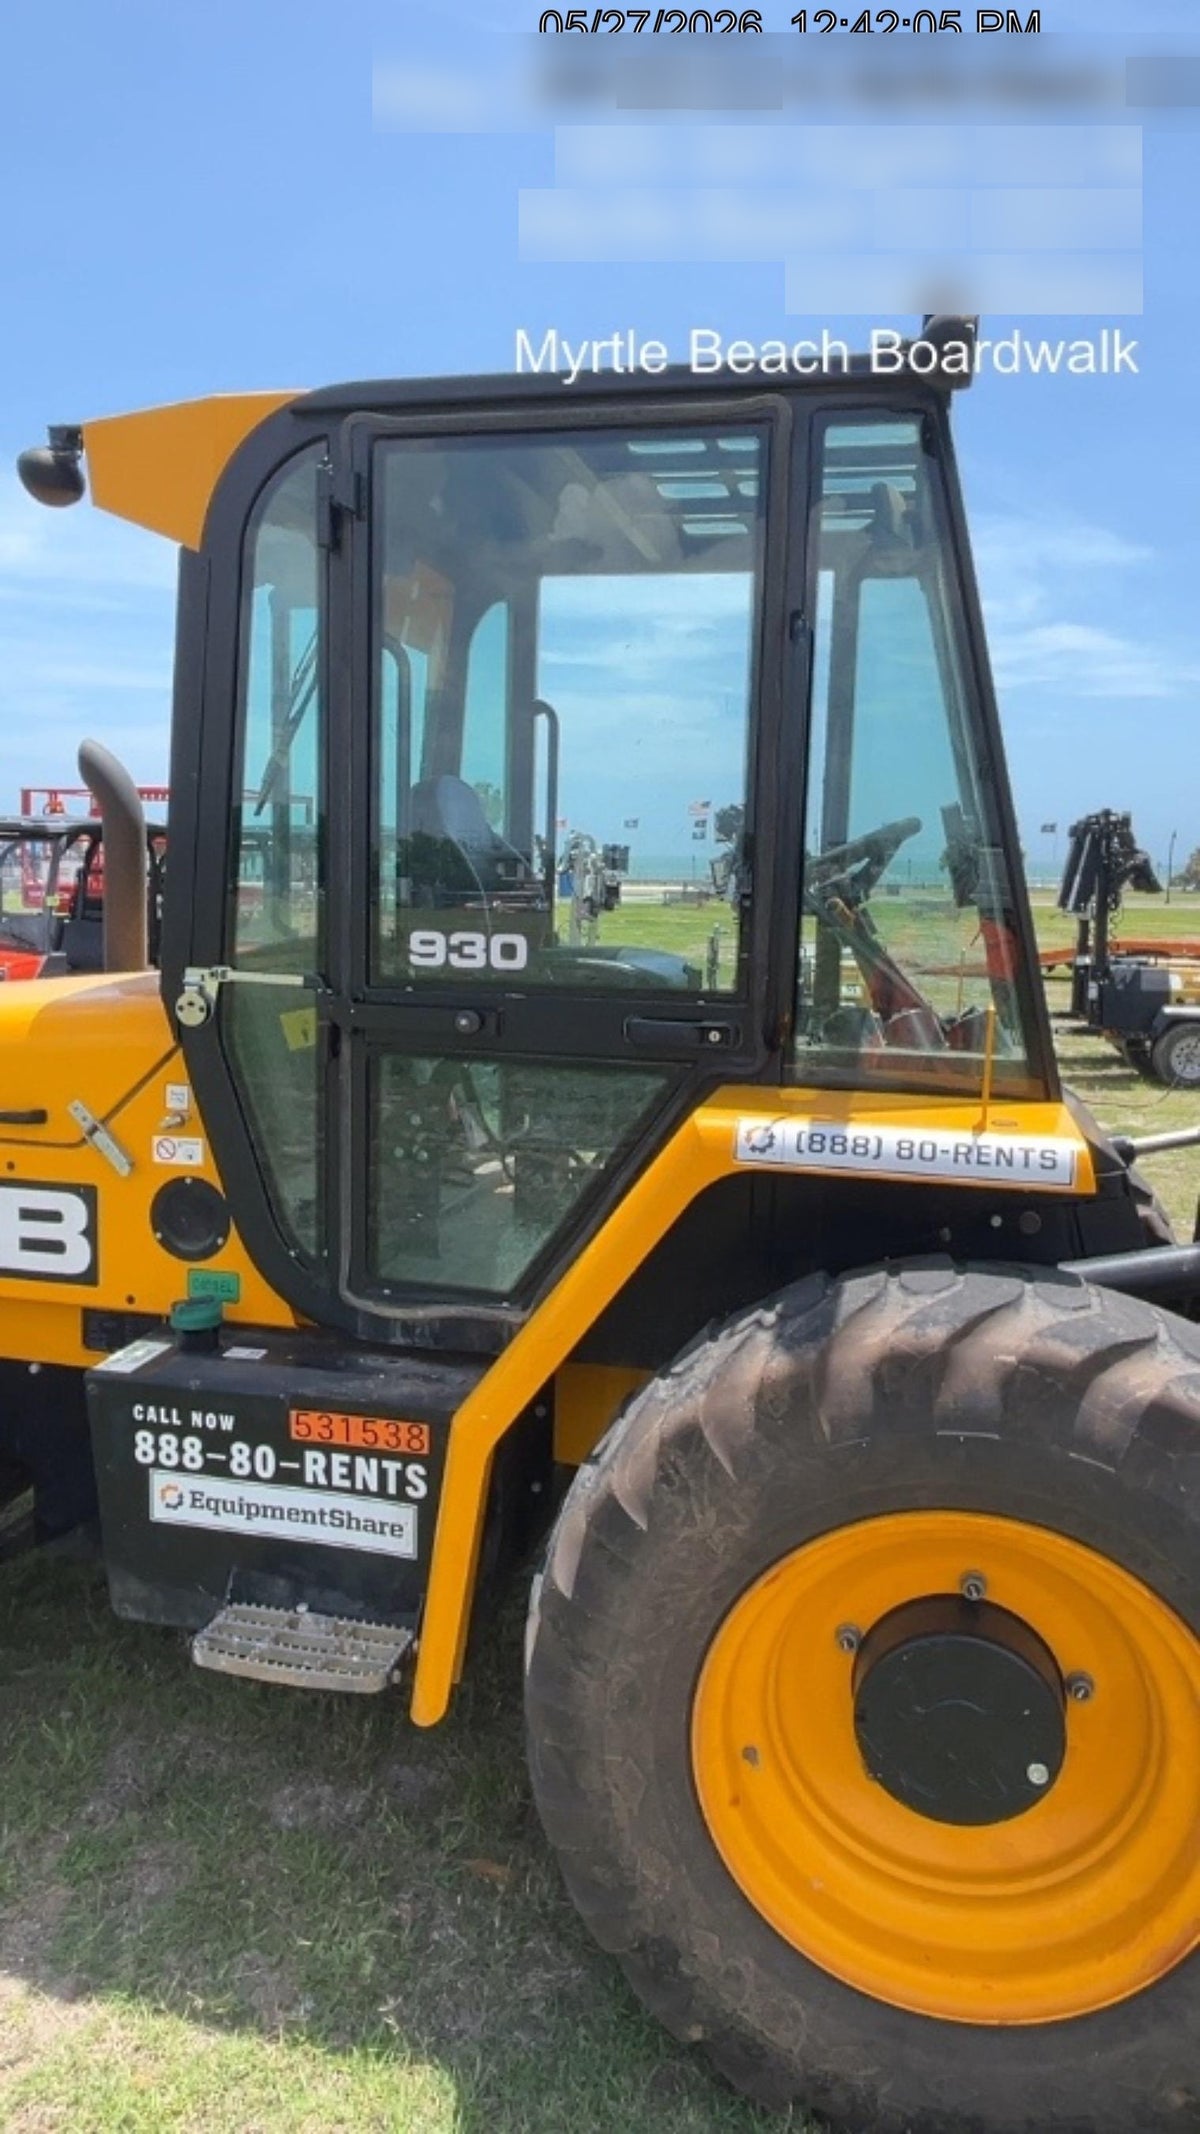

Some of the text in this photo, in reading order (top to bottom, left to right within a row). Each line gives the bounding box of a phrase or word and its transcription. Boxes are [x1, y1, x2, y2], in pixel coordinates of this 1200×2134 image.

[409, 930, 528, 971] 930
[795, 1131, 1058, 1170] (888) 80-RENTS
[132, 1404, 236, 1432] CALL NOW
[294, 1412, 427, 1453] 531538
[133, 1430, 429, 1500] 888-80-RENTS
[188, 1490, 405, 1539] EquipmentShare
